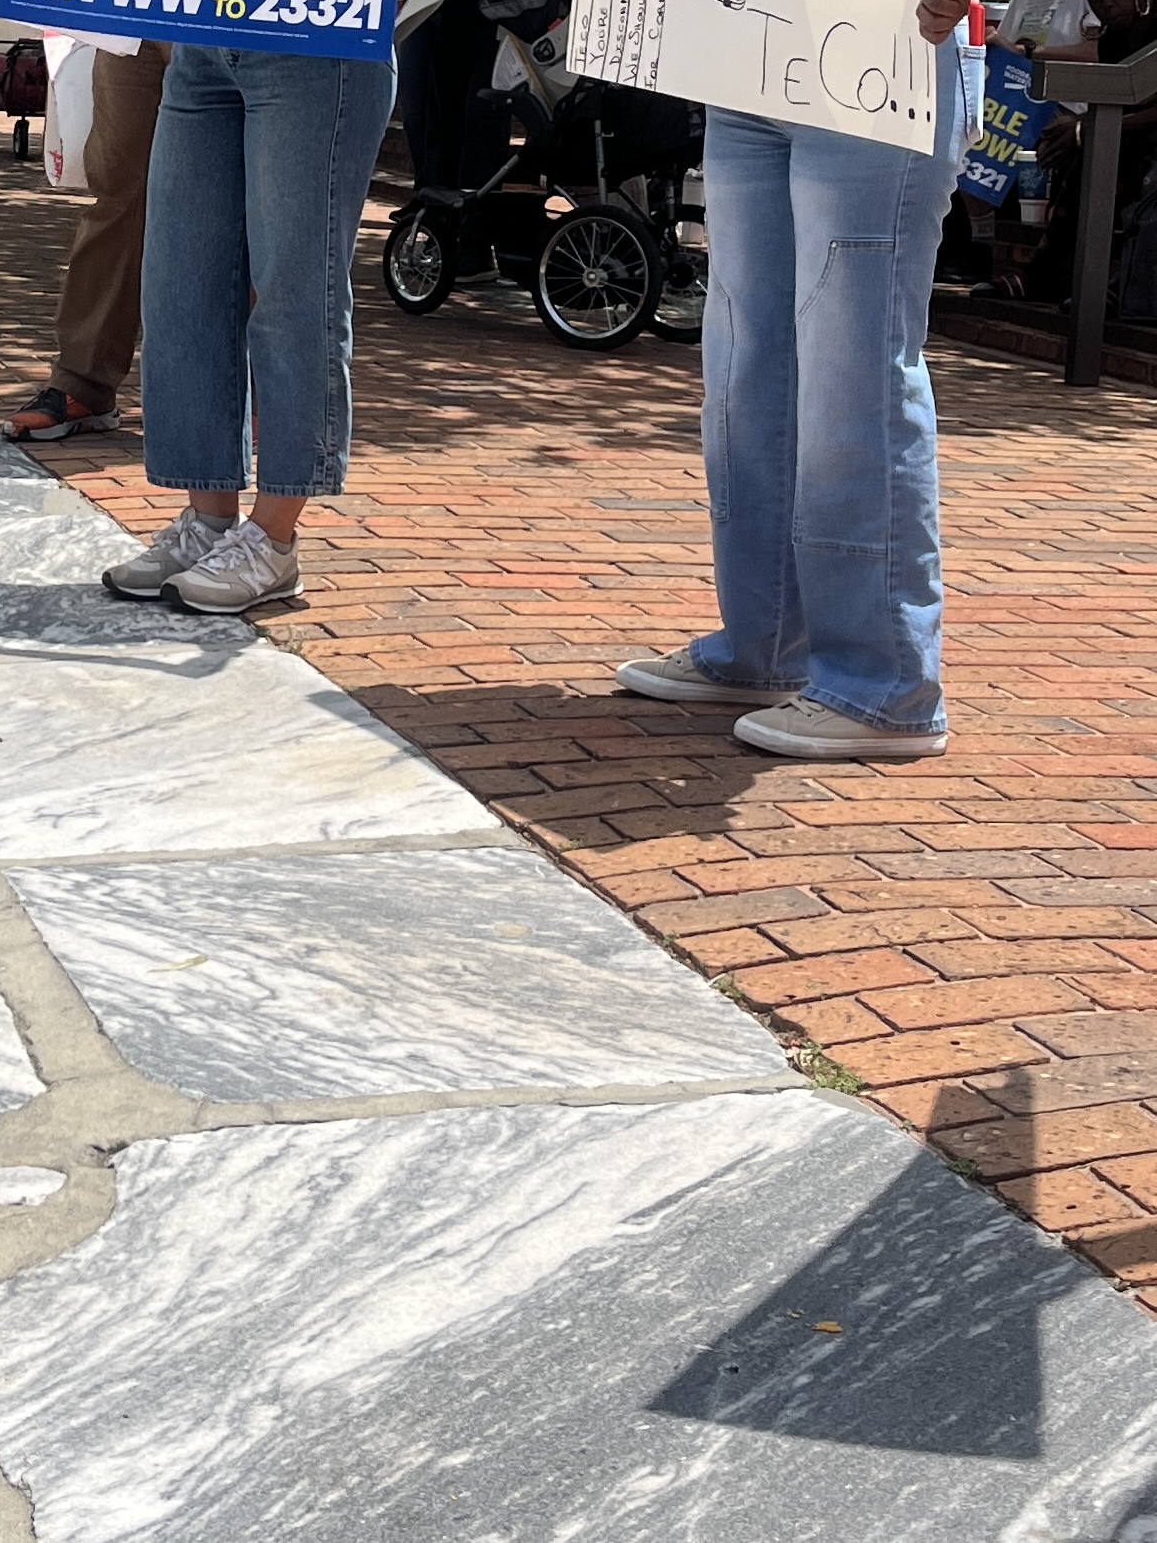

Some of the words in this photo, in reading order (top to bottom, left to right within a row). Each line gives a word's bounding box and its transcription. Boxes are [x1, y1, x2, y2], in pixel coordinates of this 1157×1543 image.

[623, 53, 637, 82] WE
[644, 60, 658, 89] FOR
[984, 96, 1029, 137] BLE
[964, 160, 1008, 193] 321
